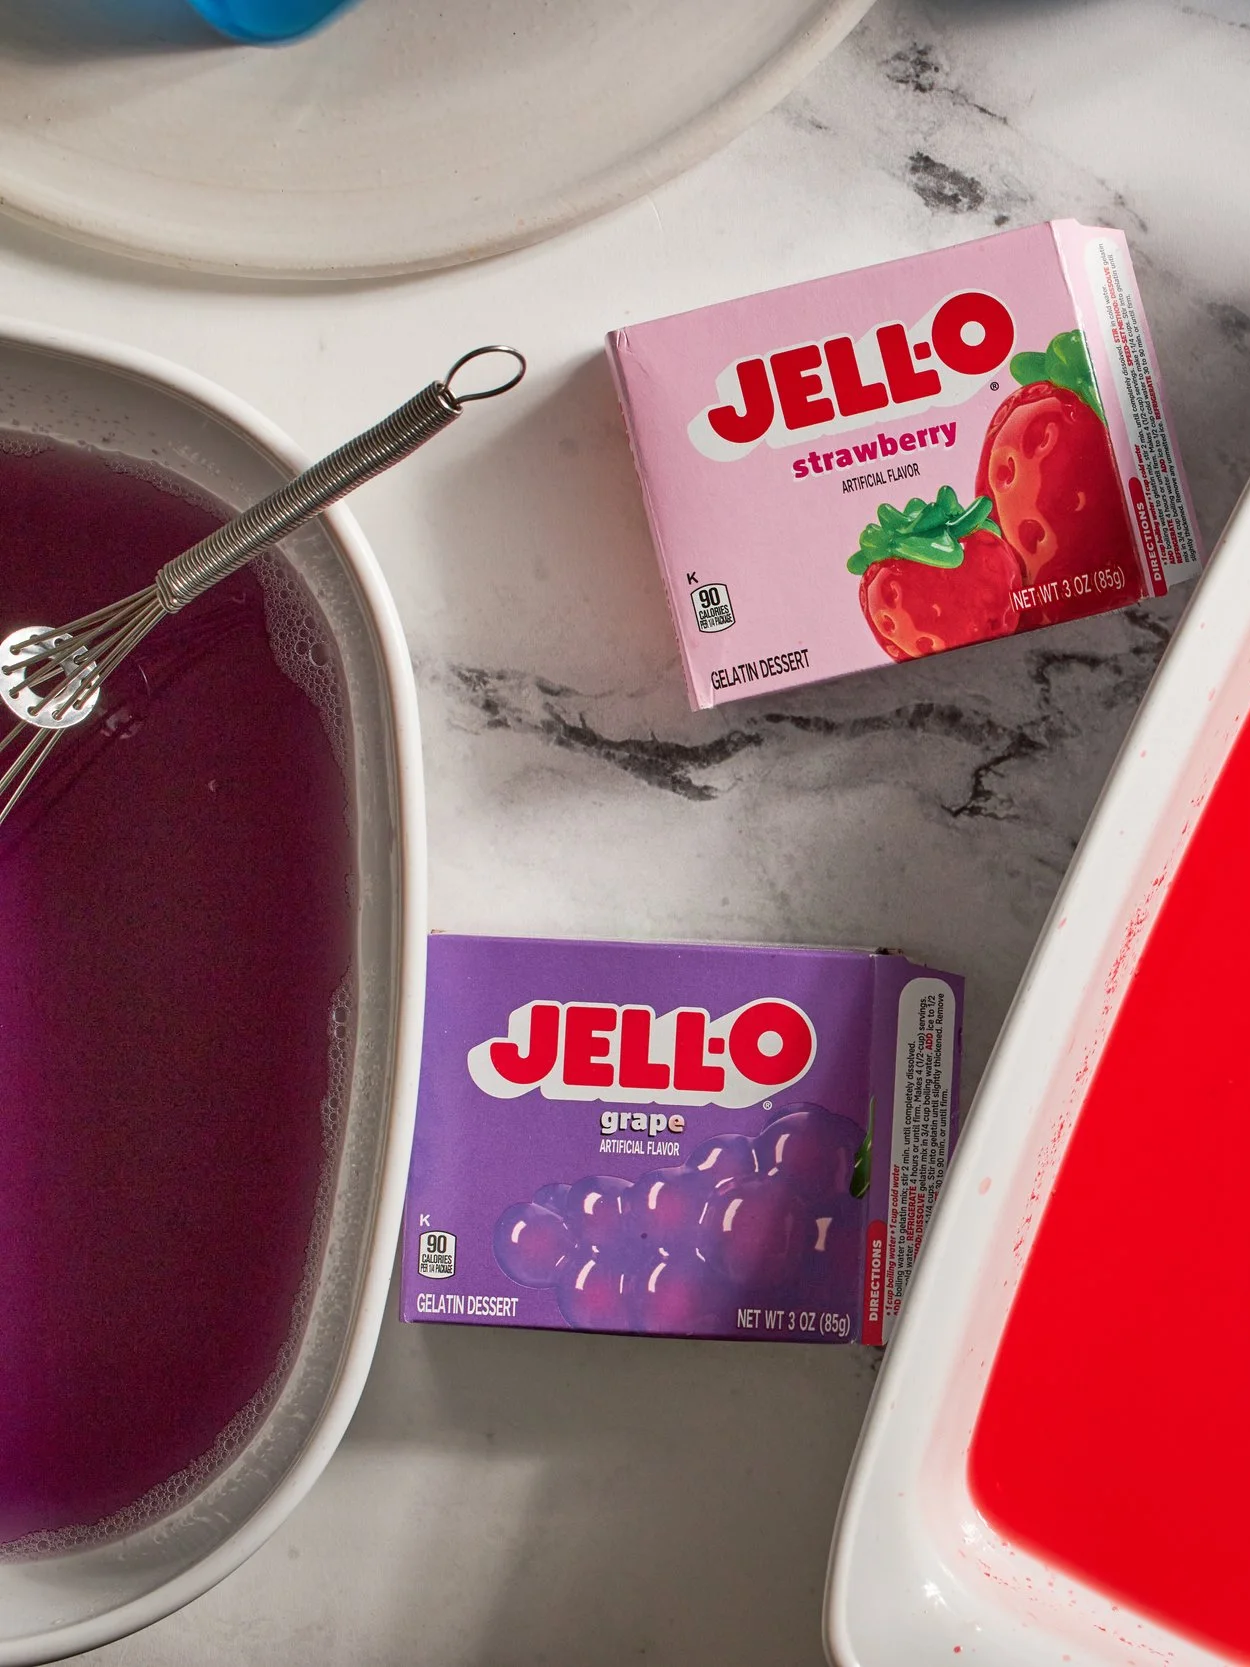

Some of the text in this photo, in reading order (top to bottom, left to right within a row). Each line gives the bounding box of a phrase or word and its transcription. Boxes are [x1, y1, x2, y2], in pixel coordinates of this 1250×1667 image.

[1098, 243, 1108, 266] gelatin
[1101, 285, 1109, 305] water.
[1104, 267, 1115, 299] DISSOLVE
[1112, 300, 1123, 331] METHOD:
[1125, 320, 1133, 338] cups.
[1116, 345, 1127, 376] dissolved.
[1120, 331, 1132, 367] SPEED-SET
[1139, 349, 1145, 357] 90
[707, 291, 1015, 444] JELL-O
[1133, 355, 1141, 373] make
[1144, 367, 1149, 375] 30
[1124, 377, 1138, 413] completely
[1130, 368, 1141, 396] servings.
[1140, 382, 1148, 400] water
[1146, 376, 1160, 420] REFRIGERATE
[1137, 397, 1148, 426] (1/2-cup)
[792, 421, 957, 480] strawberry
[1146, 433, 1154, 453] Makes
[1155, 440, 1160, 448] to
[1160, 434, 1171, 464] unmelted
[842, 462, 921, 494] ARTIFICIAL FLAVOR
[1149, 476, 1159, 499] gelatin
[1160, 486, 1164, 494] or
[1164, 475, 1172, 495] water.
[1171, 478, 1181, 503] Remove
[1161, 495, 1169, 513] hours
[1169, 496, 1178, 518] boiling
[1157, 508, 1165, 527] water
[1178, 505, 1190, 538] thickened.
[1136, 502, 1161, 582] DIRECTIONS
[1161, 525, 1172, 550] boiling
[1167, 520, 1182, 564] REFRIGERATE
[1186, 538, 1197, 562] slightly
[686, 571, 699, 585] K
[1012, 565, 1126, 611] NET WT 3 OZ (85g)
[698, 587, 721, 609] 90
[698, 604, 730, 620] CALORIES
[699, 619, 709, 630] PER
[715, 613, 733, 626] PACKAGE
[710, 648, 810, 690] GELATIN DESSERT
[918, 997, 927, 1031] servings.
[489, 1002, 813, 1093] JELL-O
[916, 1033, 926, 1068] (1/2-cup)
[934, 1027, 942, 1067] thickened.
[907, 1042, 915, 1080] dissolved.
[924, 1079, 932, 1105] boiling
[933, 1070, 942, 1098] slightly
[905, 1082, 915, 1125] completely
[600, 1111, 685, 1137] grape
[930, 1120, 939, 1146] gelatin
[599, 1139, 680, 1156] ARTIFICIAL FLAVOR
[914, 1145, 919, 1153] or
[937, 1170, 943, 1178] to
[938, 1158, 944, 1167] 90
[919, 1165, 928, 1192] gelatin
[901, 1188, 909, 1204] mix;
[420, 1213, 431, 1227] K
[899, 1207, 908, 1234] gelatin
[908, 1187, 917, 1241] REFRIGERATE
[916, 1194, 925, 1233] DISSOLVE
[426, 1234, 447, 1254] 90
[899, 1236, 905, 1244] to
[420, 1263, 428, 1272] PER
[435, 1264, 453, 1274] PACKAGE
[421, 1253, 452, 1264] CALORIES
[869, 1240, 882, 1321] DIRECTIONS
[887, 1262, 896, 1288] boiling
[896, 1269, 905, 1297] boiling
[417, 1293, 519, 1317] GELATIN DESSERT
[737, 1308, 851, 1337] NET WT 3 OZ (85g)
